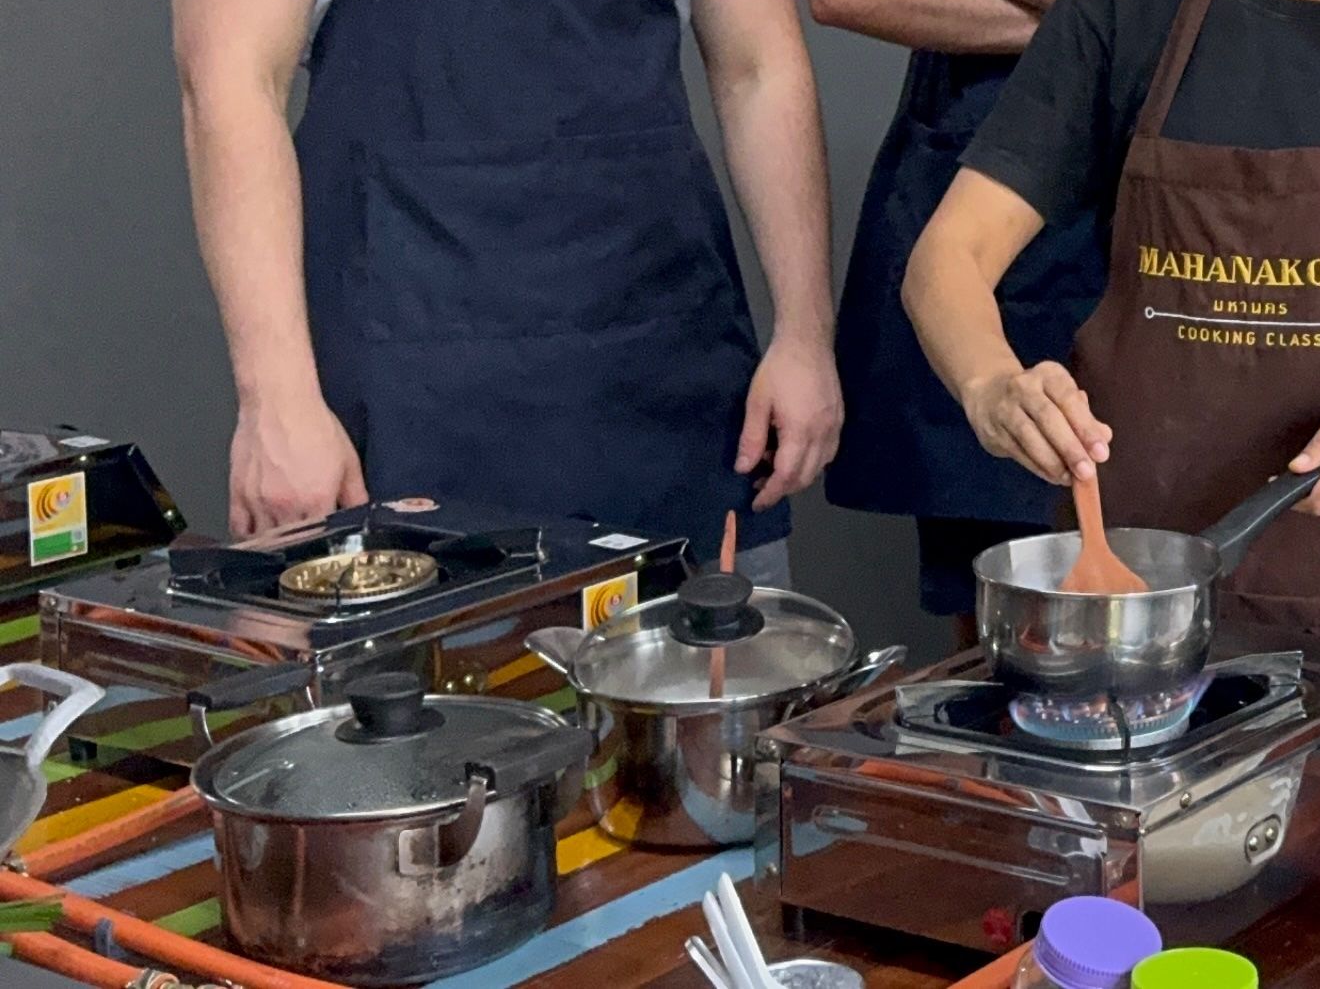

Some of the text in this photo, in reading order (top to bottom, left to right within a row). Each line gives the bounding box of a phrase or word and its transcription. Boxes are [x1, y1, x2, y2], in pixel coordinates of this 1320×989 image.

[1213, 299, 1288, 315] มหานคร
[1177, 325, 1256, 346] COOKING
